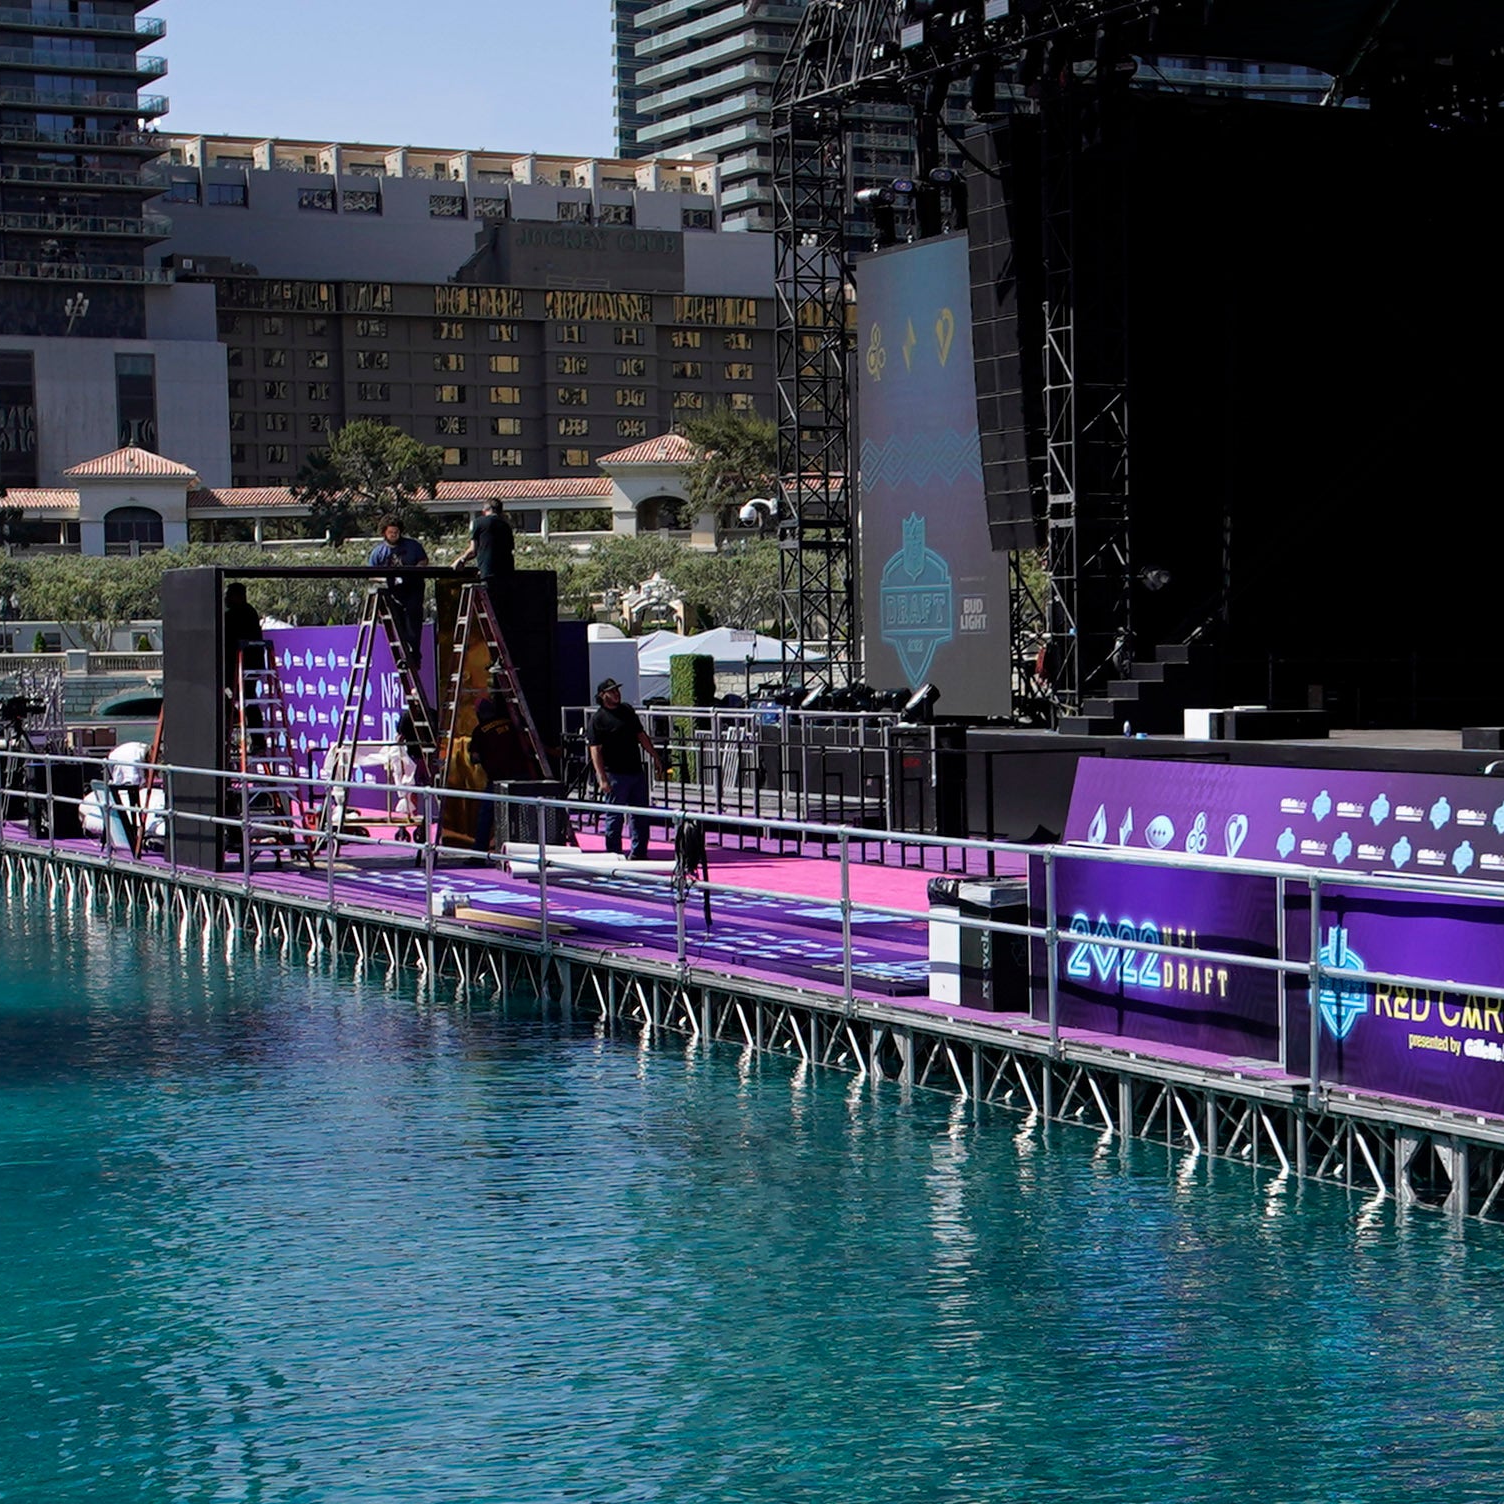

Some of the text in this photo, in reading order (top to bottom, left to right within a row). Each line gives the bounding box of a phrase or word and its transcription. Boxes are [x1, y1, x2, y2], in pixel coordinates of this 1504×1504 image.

[516, 228, 676, 253] JOCKEY CLUB
[885, 593, 946, 625] DRAFT
[963, 598, 984, 613] BUD
[960, 614, 987, 630] LIGHT
[380, 672, 410, 710] NFL
[1067, 912, 1161, 988] 2022
[1163, 961, 1229, 998] DRAFT
[1374, 971, 1431, 1023] RED
[1408, 1033, 1449, 1051] presented
[1449, 1037, 1462, 1057] by
